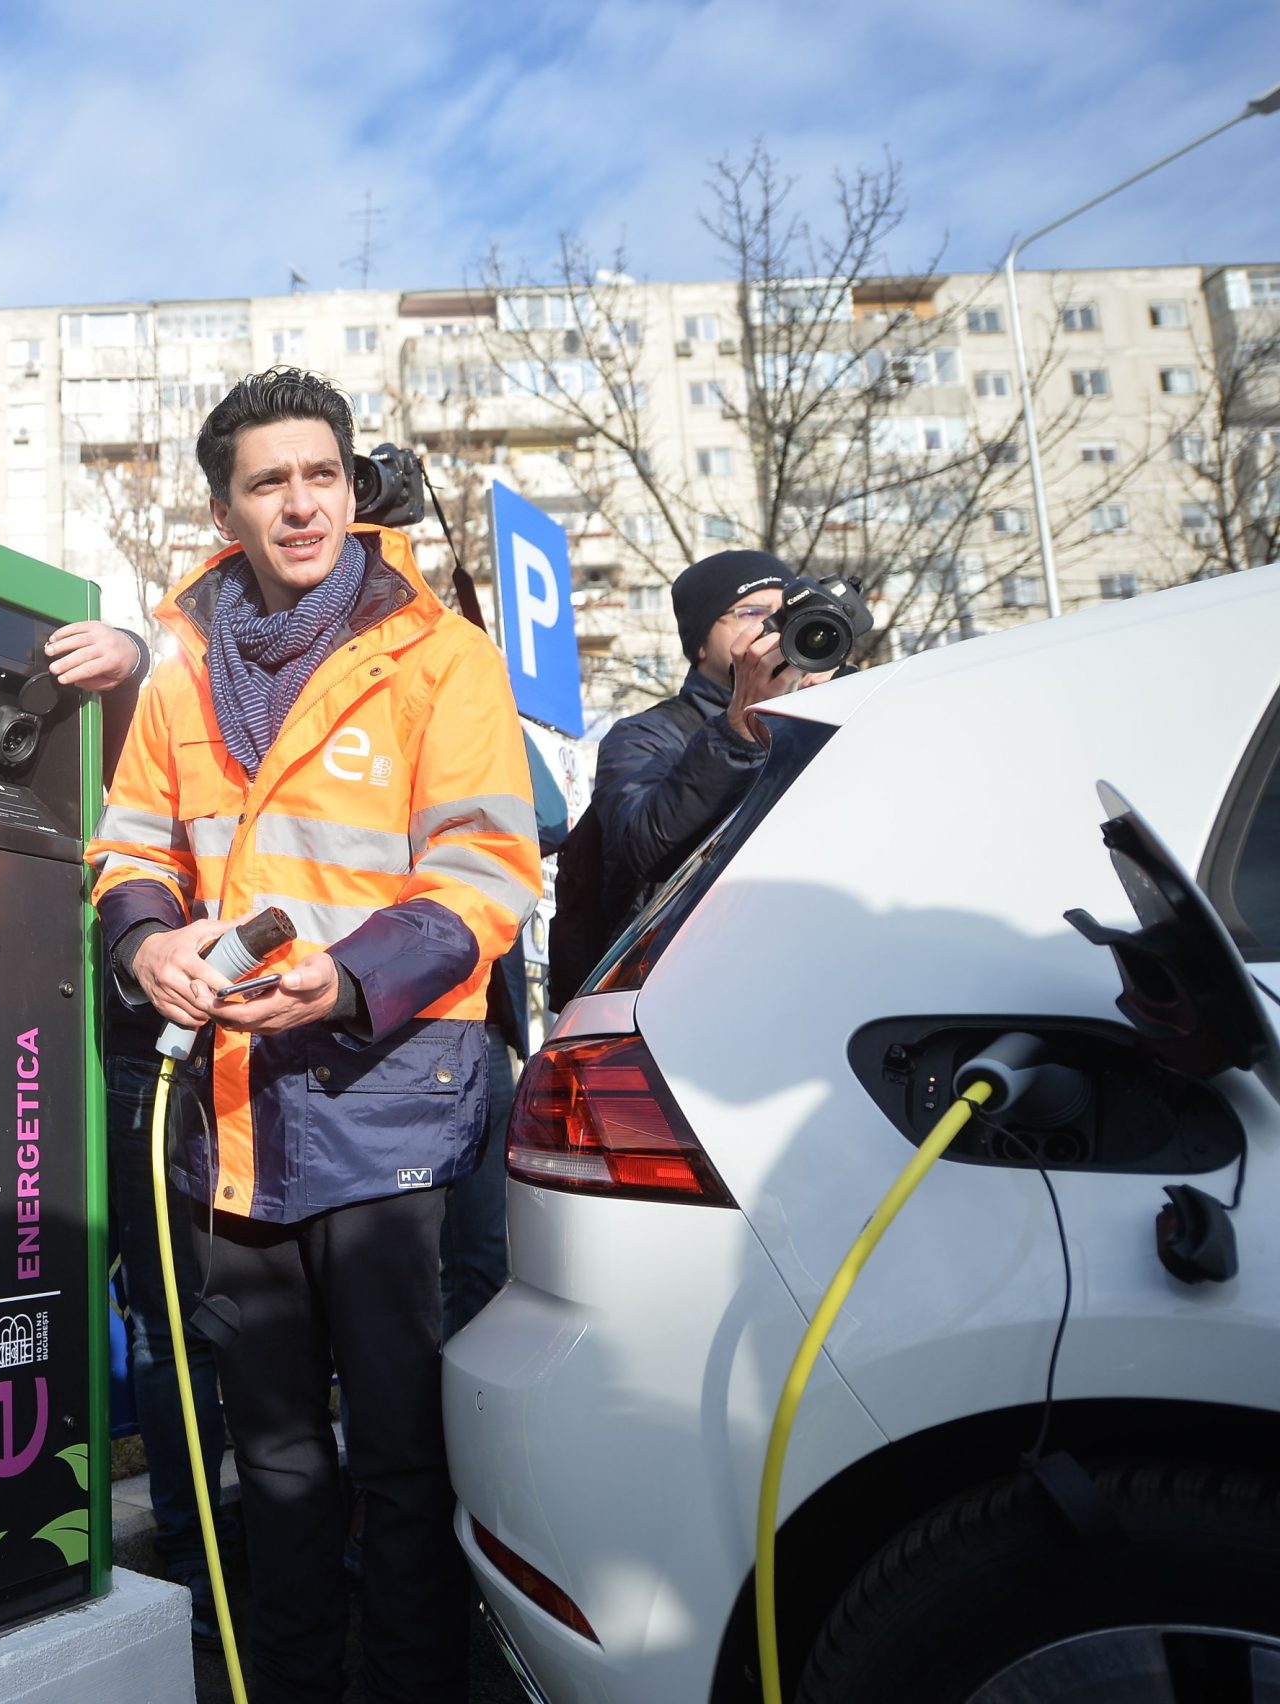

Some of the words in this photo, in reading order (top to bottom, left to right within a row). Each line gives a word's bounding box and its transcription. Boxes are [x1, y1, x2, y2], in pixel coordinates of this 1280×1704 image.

[512, 532, 559, 679] P
[787, 589, 810, 605] Canon
[16, 1027, 40, 1281] ENERGETICA
[35, 1311, 43, 1362] HOLDING
